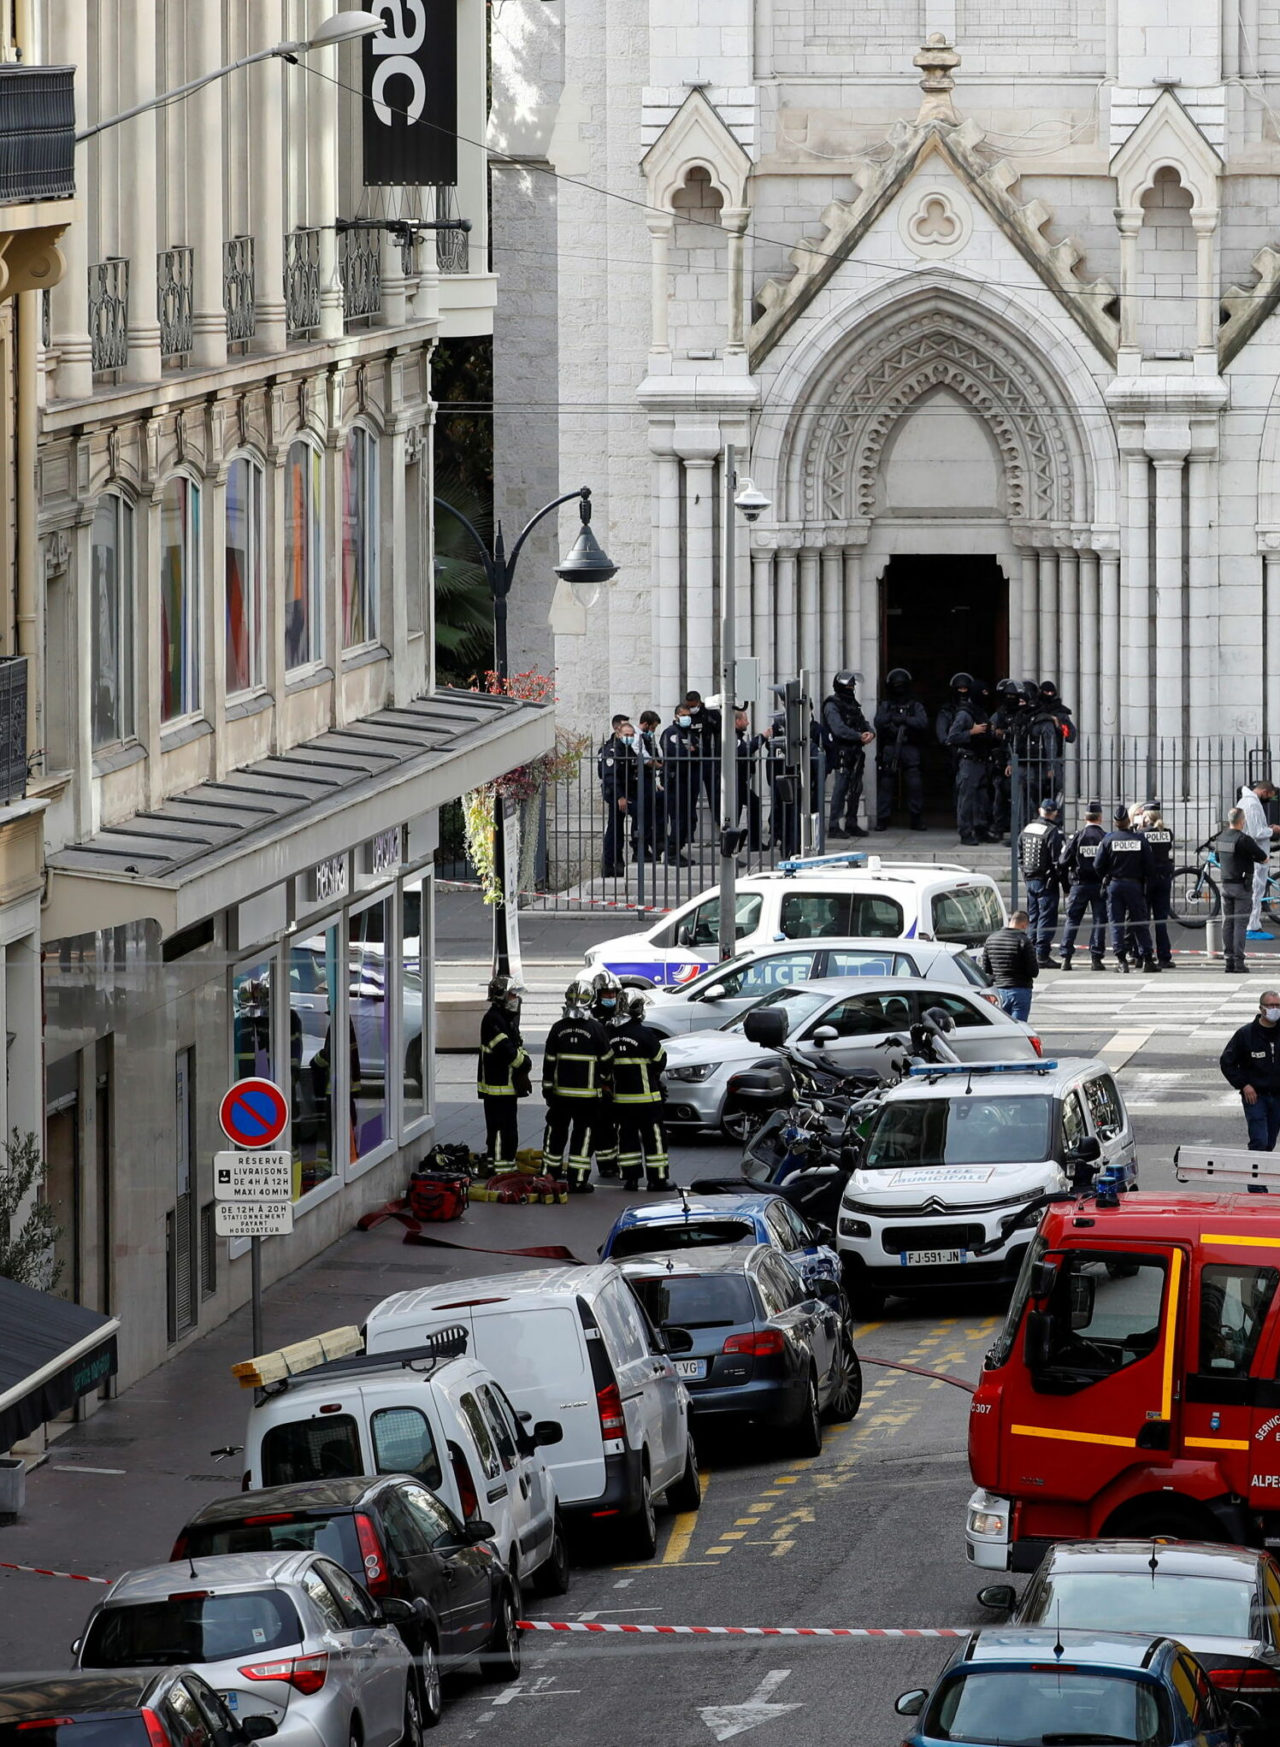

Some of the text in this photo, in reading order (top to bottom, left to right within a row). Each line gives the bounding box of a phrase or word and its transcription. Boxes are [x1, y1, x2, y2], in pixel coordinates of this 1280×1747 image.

[1146, 831, 1170, 841] POLICE
[1113, 841, 1139, 850] POLICE
[1081, 847, 1098, 856] POLI
[238, 1156, 284, 1164] RÉSERVÉ
[263, 1176, 269, 1185] À
[893, 1175, 986, 1184] MUNICIPALE
[258, 1204, 263, 1213] À
